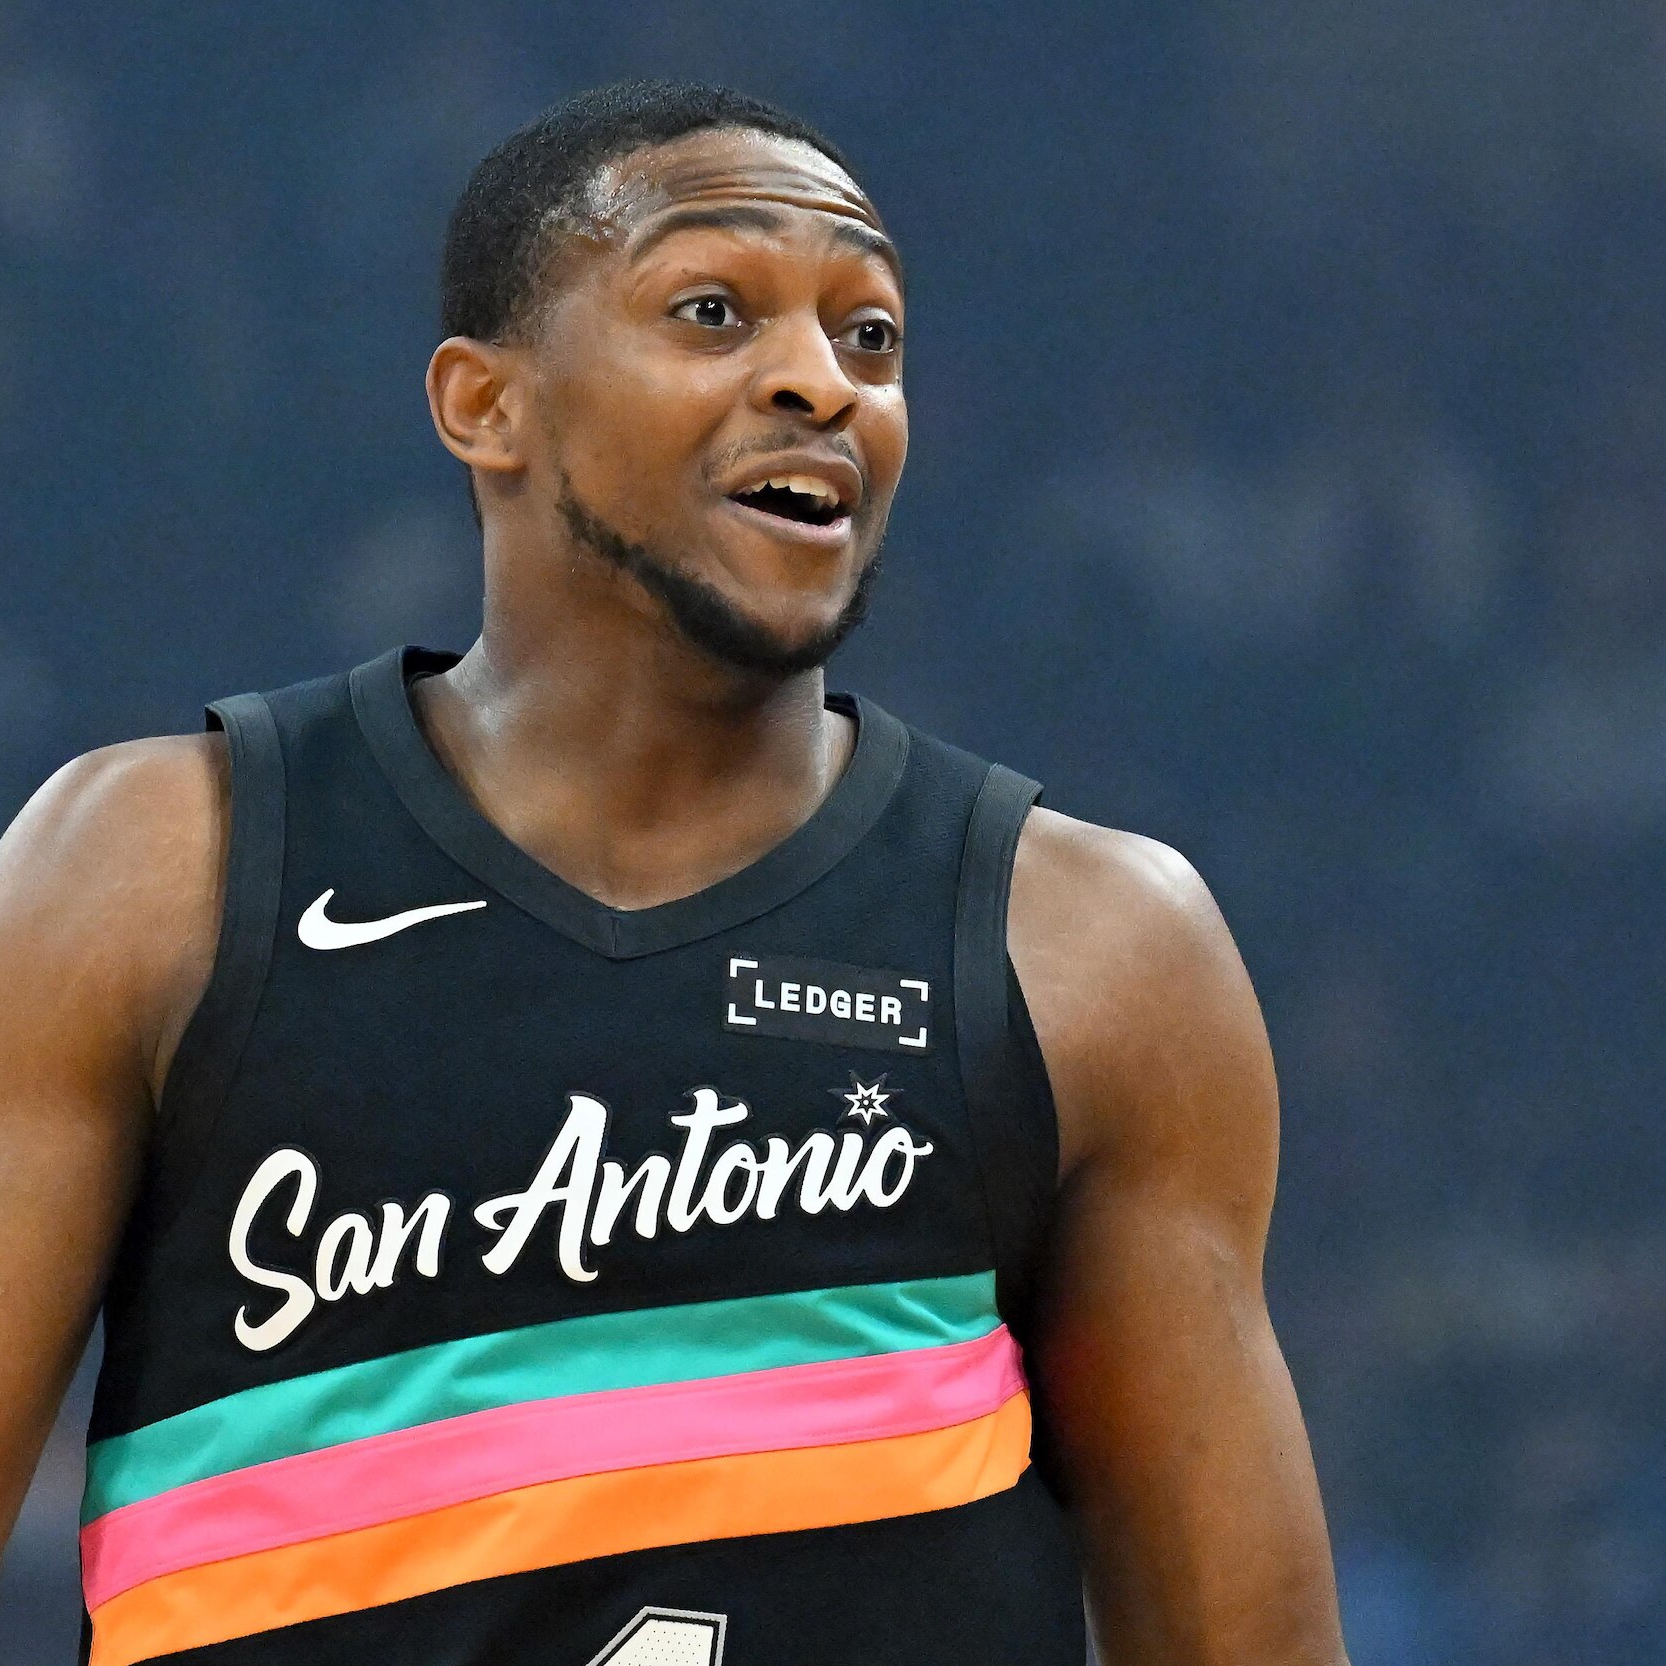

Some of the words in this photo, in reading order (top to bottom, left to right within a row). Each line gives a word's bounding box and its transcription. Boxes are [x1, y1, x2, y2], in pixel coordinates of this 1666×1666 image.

[754, 979, 902, 1025] LEDGER
[228, 1148, 452, 1351] San
[473, 1084, 934, 1282] Antonio
